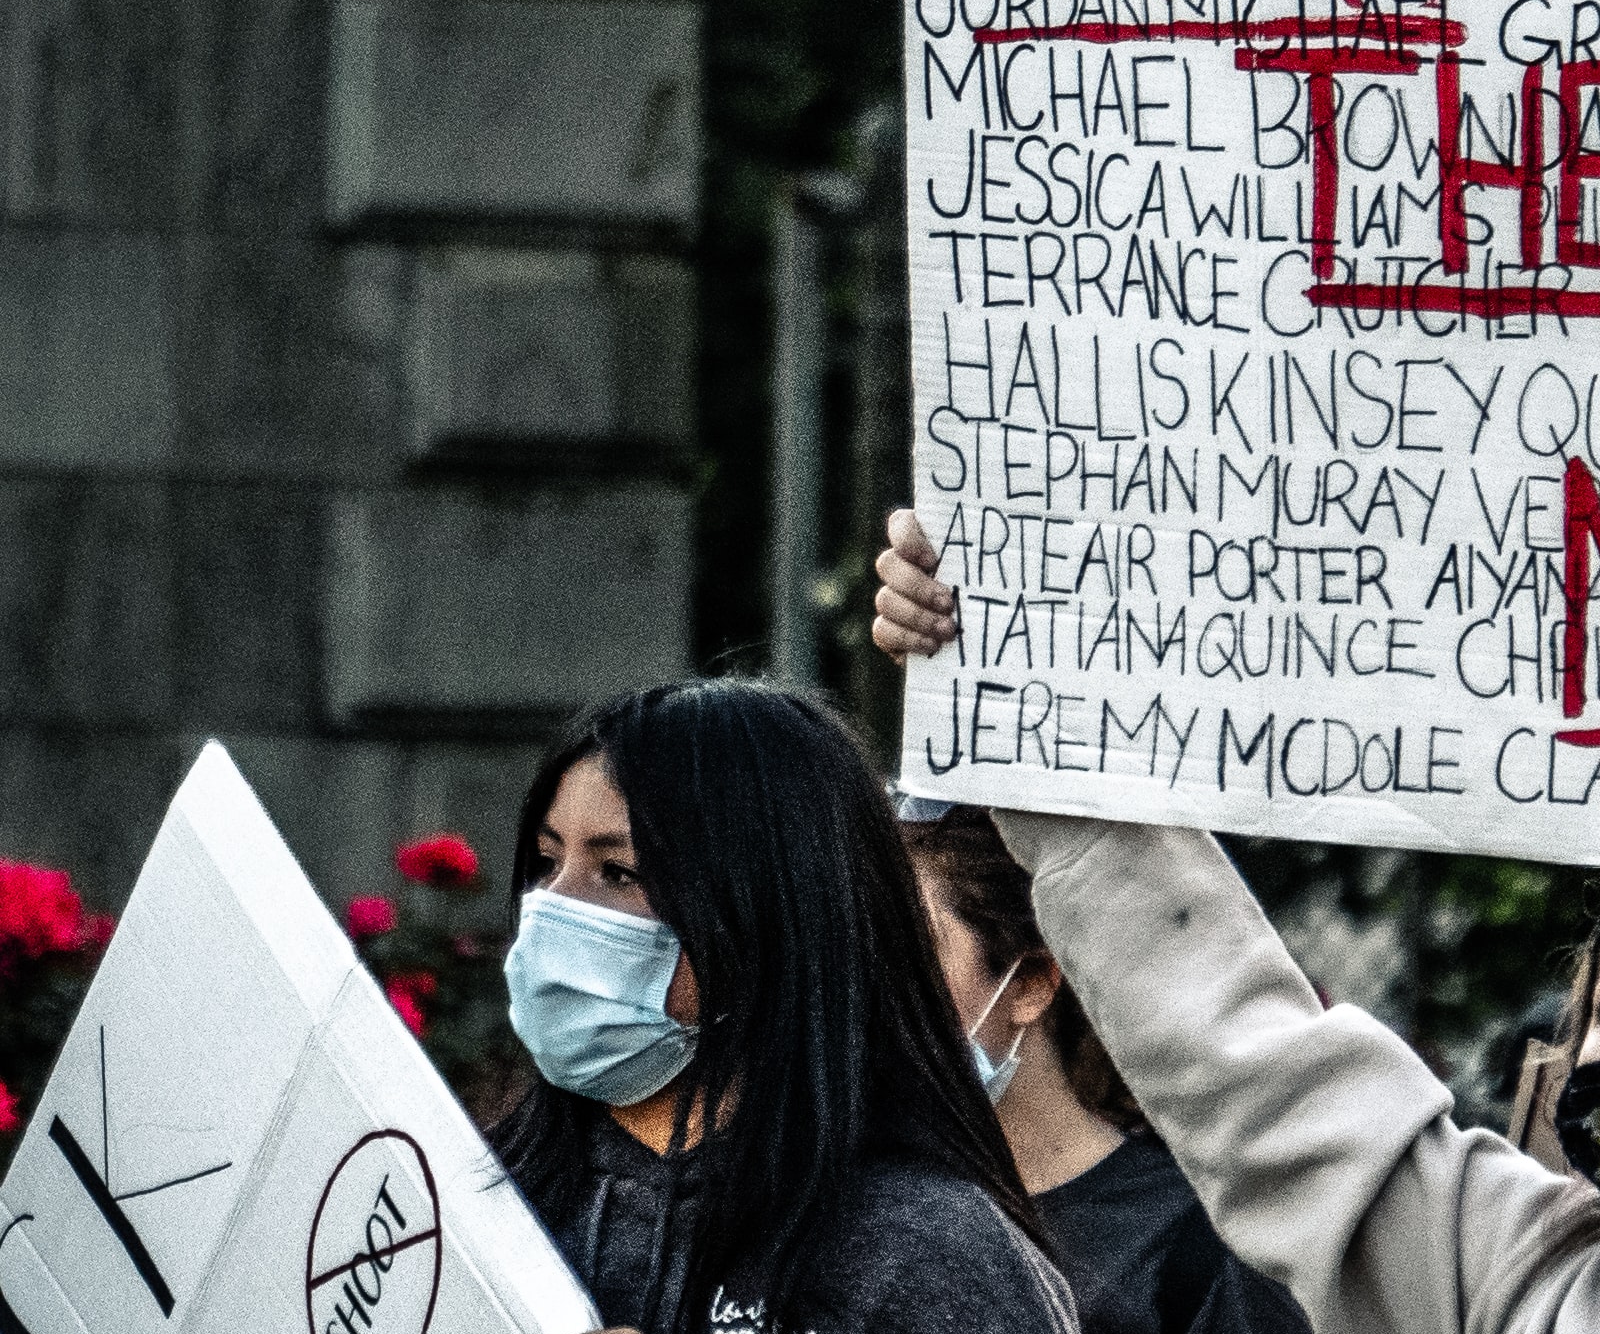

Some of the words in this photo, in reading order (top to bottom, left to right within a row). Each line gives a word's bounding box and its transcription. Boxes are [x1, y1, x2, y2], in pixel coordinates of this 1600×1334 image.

[924, 41, 1226, 152] MICHAEL
[1249, 67, 1515, 178] BROWN
[926, 128, 1170, 239] JESSICA
[1180, 166, 1495, 248] WILLIAMS
[929, 230, 1251, 334] TERRANCE
[1260, 248, 1573, 340] CRUTCHER
[943, 312, 1190, 442] HALLIS
[1210, 345, 1505, 456] KINSEY
[926, 405, 1200, 517] STEPHAN
[1218, 452, 1446, 547] MURAY
[931, 501, 1158, 597] ARTEAIR
[1188, 528, 1395, 610] PORTER
[1196, 610, 1437, 682] QUINCE
[926, 677, 1200, 792] JEREMY
[1216, 705, 1465, 801] MCDOLE
